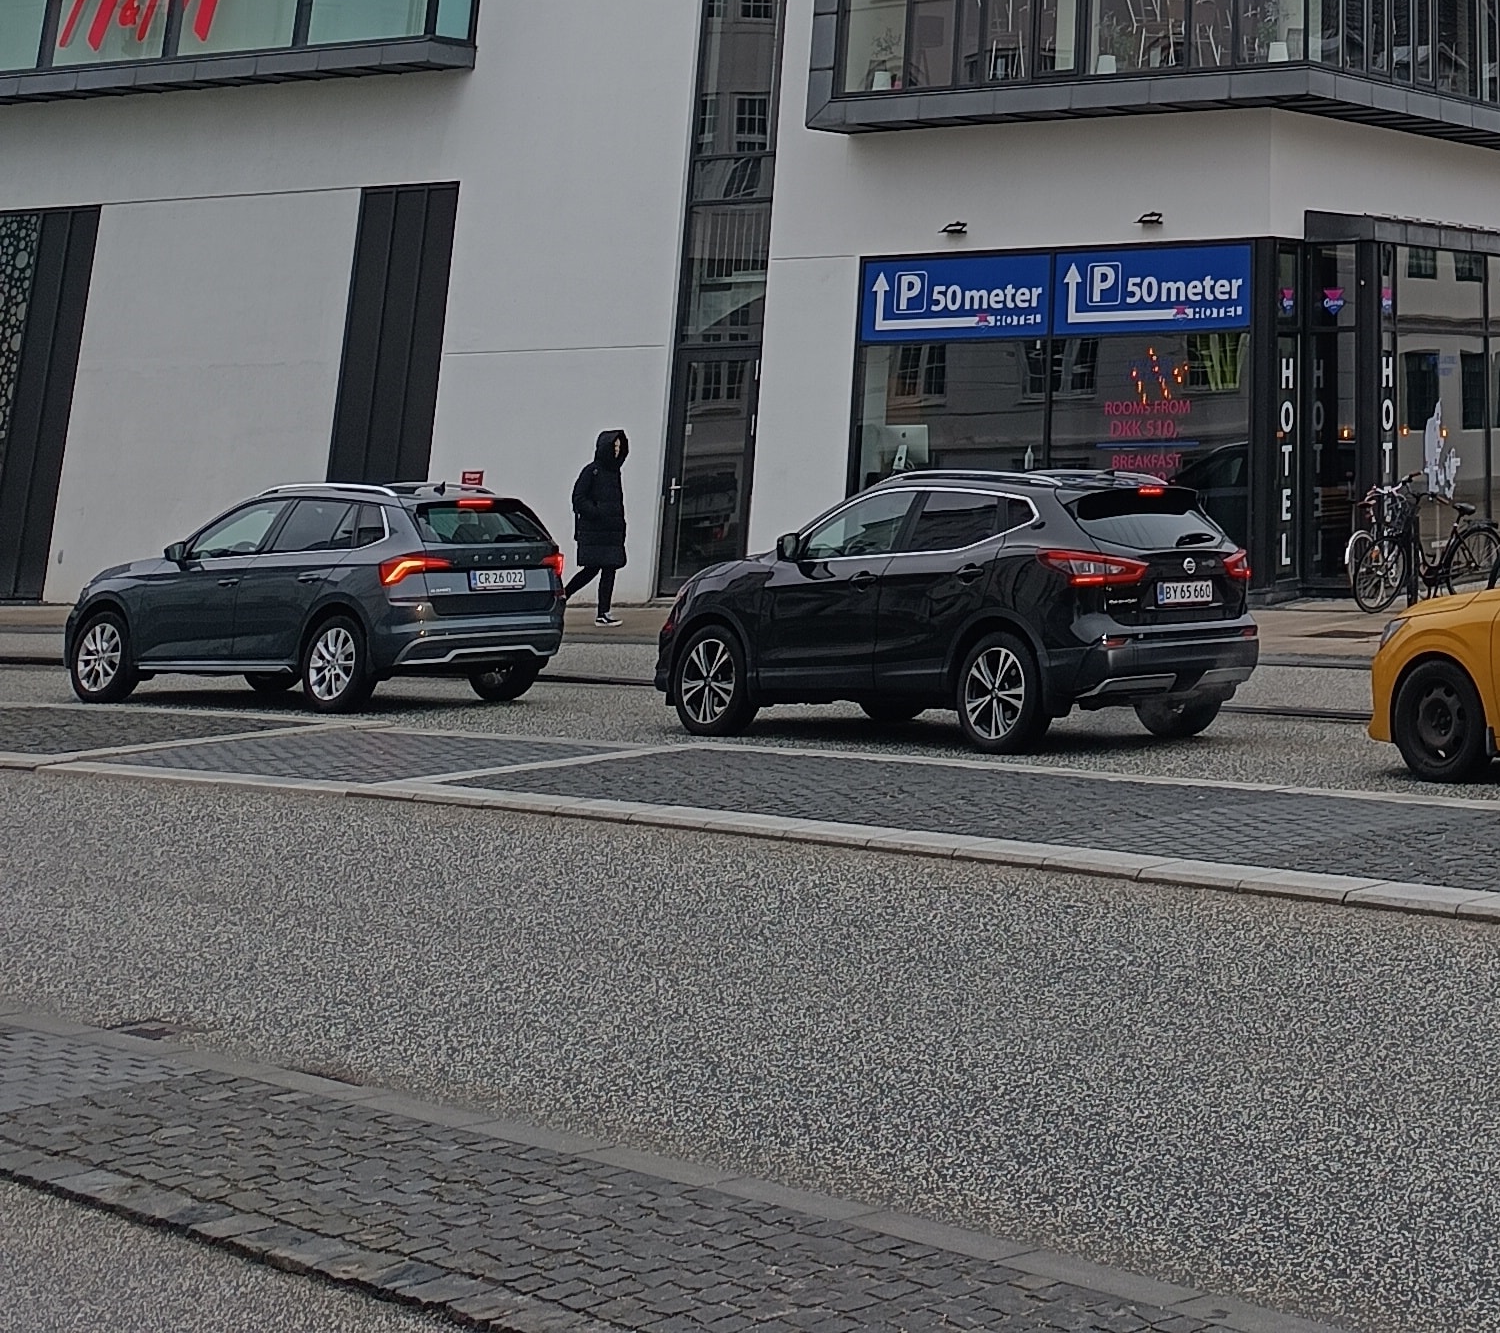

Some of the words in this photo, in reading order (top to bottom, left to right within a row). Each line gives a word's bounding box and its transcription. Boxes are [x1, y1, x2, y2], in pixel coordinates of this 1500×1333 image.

[1093, 266, 1116, 302] P
[899, 275, 922, 310] P
[1104, 401, 1151, 415] ROOMS
[1154, 400, 1191, 414] FROM
[1110, 421, 1142, 437] DKK
[1112, 453, 1182, 469] BREAKFAST
[1280, 357, 1294, 566] HOTEL
[478, 572, 491, 584] CR
[493, 572, 505, 584] 26
[506, 571, 524, 583] 022
[1165, 585, 1178, 600] BY
[1180, 584, 1192, 599] 65
[1194, 583, 1211, 598] 660
